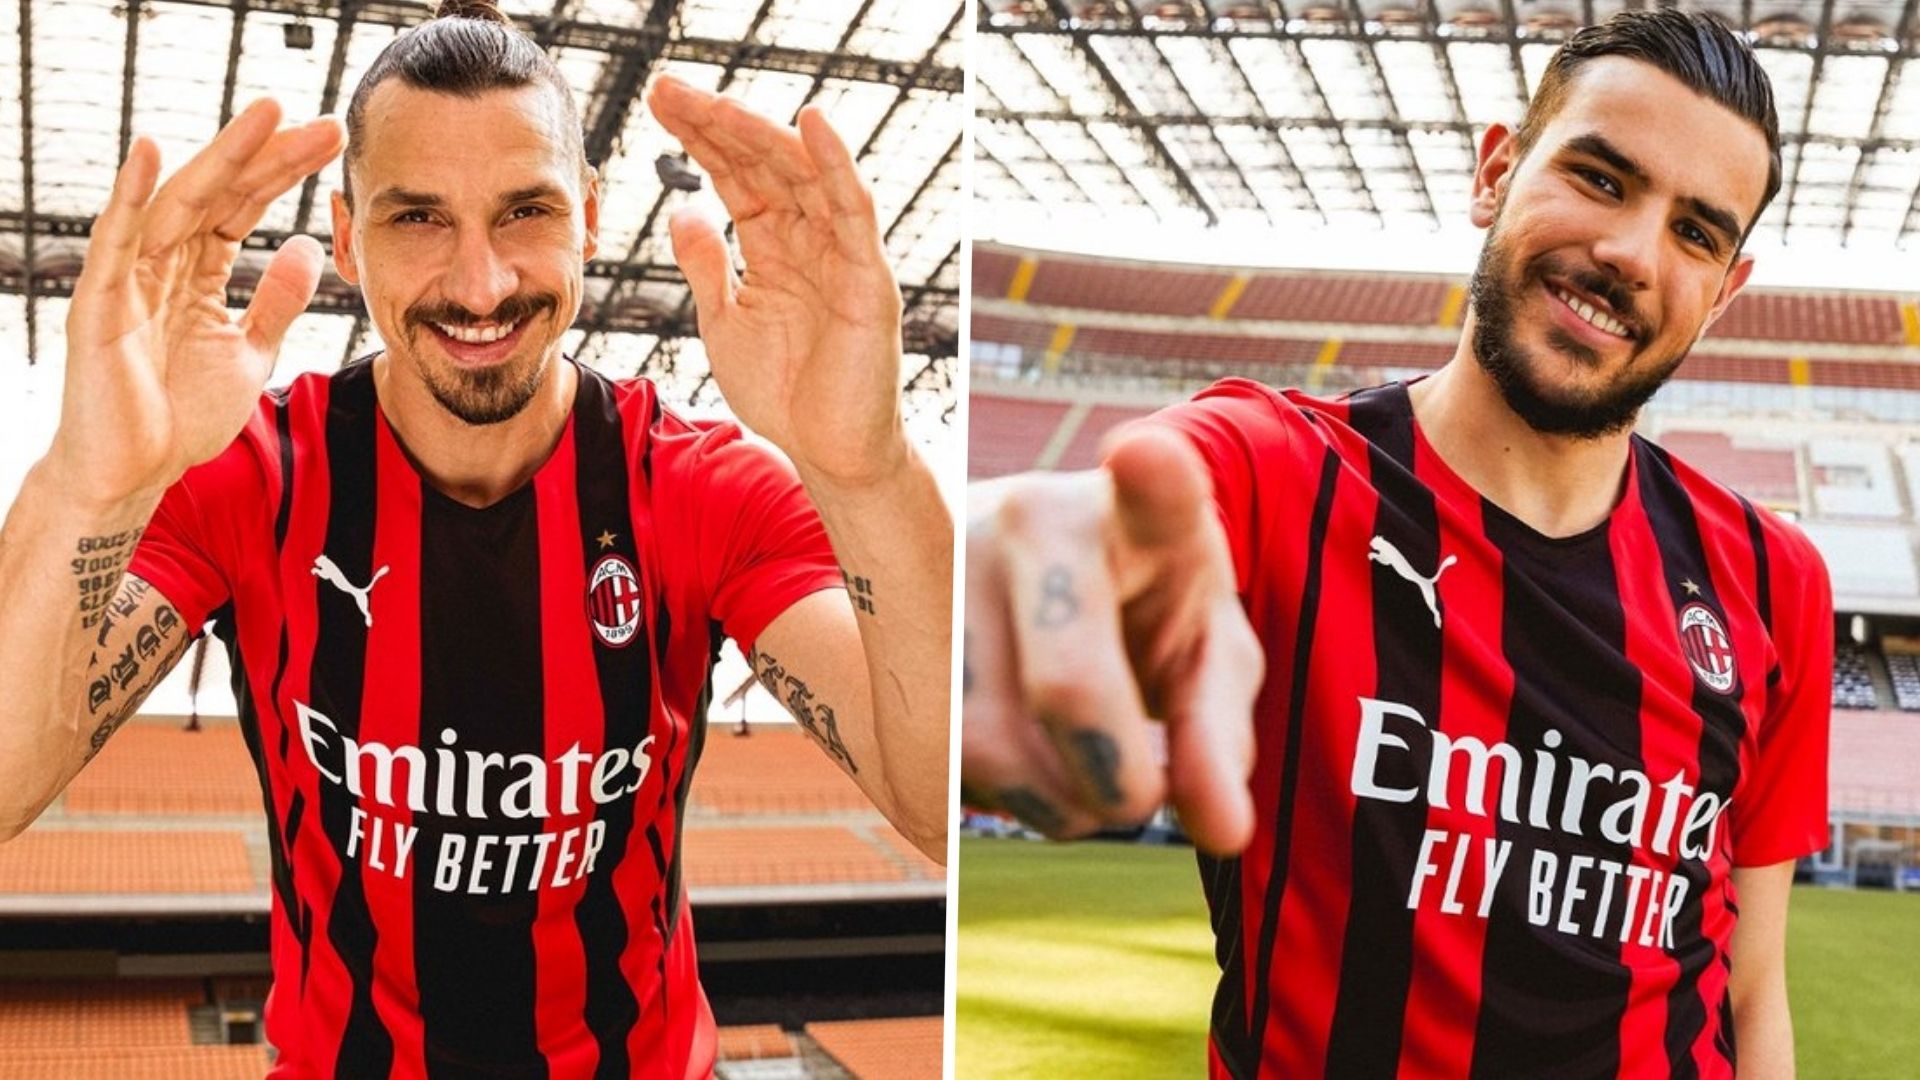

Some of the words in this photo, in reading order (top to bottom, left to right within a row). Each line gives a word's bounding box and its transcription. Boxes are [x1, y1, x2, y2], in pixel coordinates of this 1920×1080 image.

[597, 561, 628, 581] ACM
[604, 624, 633, 638] 1899
[1687, 609, 1718, 629] ACM
[292, 698, 655, 819] Emirates
[1350, 696, 1733, 862] Emirates
[347, 805, 419, 879] FLY
[434, 820, 606, 895] BETTER
[1406, 829, 1513, 918] FLY
[1527, 849, 1690, 949] BETTER
